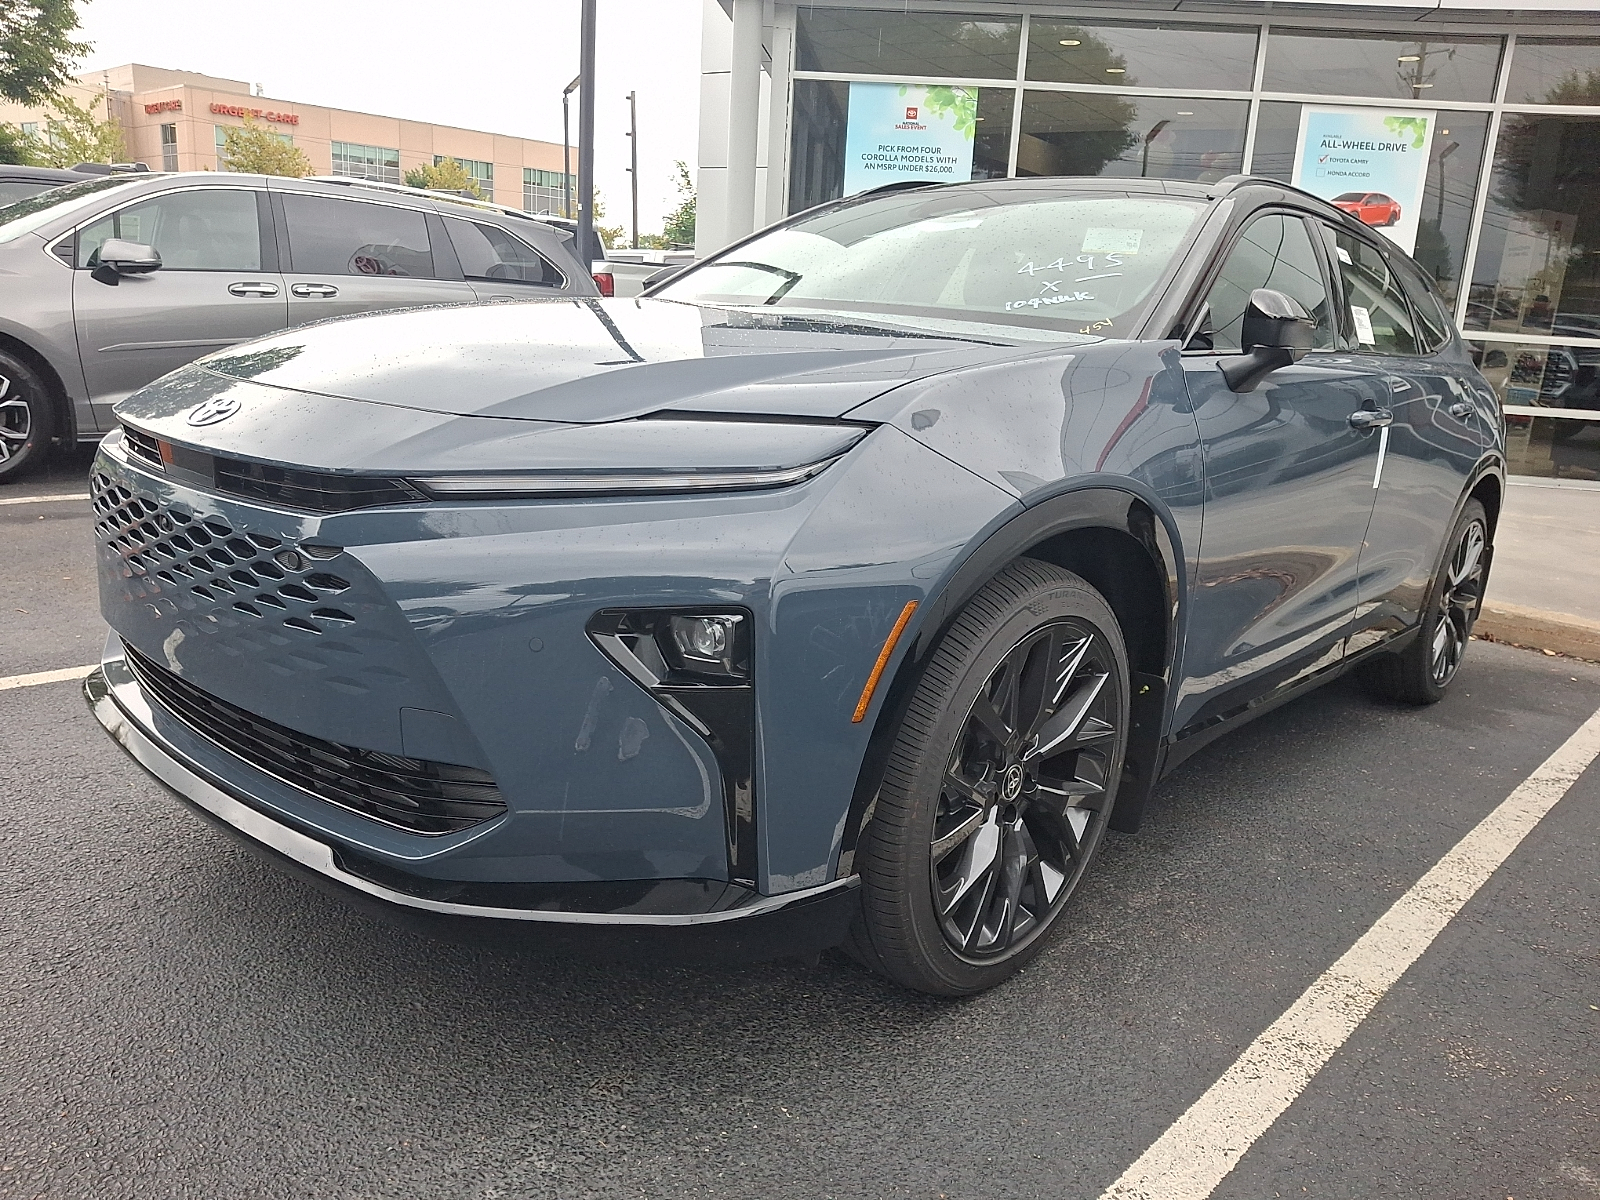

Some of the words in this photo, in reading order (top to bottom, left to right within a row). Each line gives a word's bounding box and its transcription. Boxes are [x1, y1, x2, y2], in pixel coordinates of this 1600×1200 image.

[266, 110, 300, 125] CARE
[878, 144, 896, 153] PICK
[896, 145, 919, 154] FROM
[920, 146, 942, 155] FOUR
[1320, 139, 1376, 152] ALL-WHEEL
[1377, 142, 1407, 153] DRIVE
[861, 153, 899, 163] COROLLA
[900, 154, 934, 164] MODELS
[935, 156, 958, 165] WITH
[1329, 157, 1350, 165] TOYOTA
[864, 162, 876, 171] AN
[876, 162, 897, 172] MSRP
[898, 164, 924, 173] UNDER
[924, 164, 955, 174] $26,000.
[1018, 252, 1124, 277] 4495
